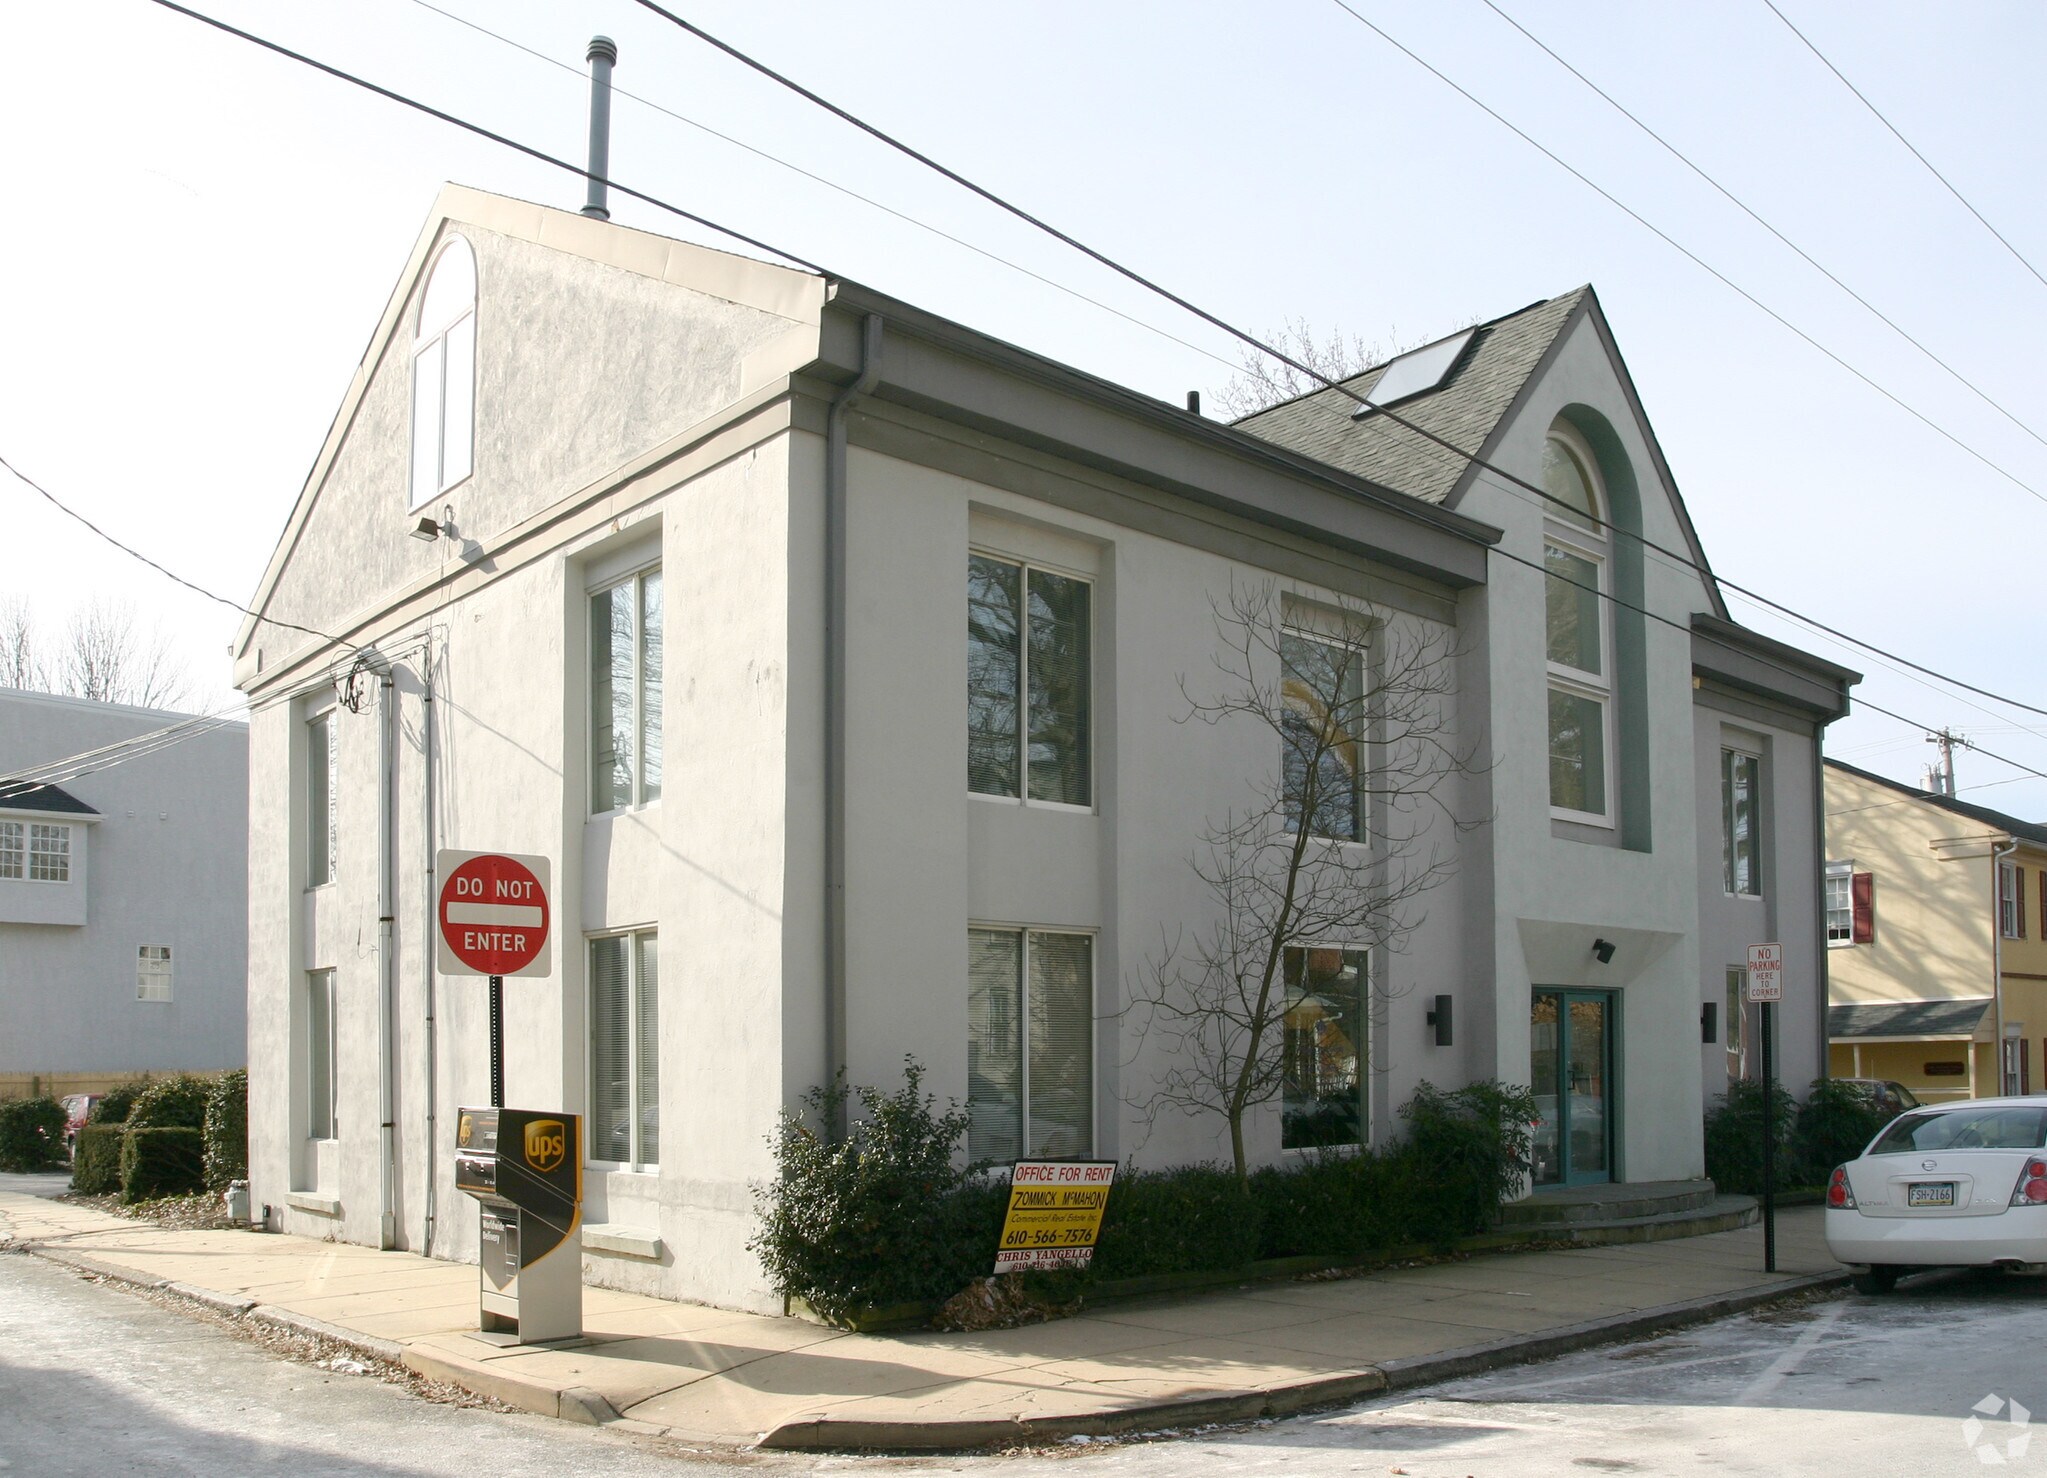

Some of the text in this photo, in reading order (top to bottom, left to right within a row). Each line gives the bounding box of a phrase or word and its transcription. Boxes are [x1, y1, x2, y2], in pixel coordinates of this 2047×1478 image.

[457, 877, 533, 899] DO NOT
[464, 931, 526, 952] ENTER
[1758, 949, 1771, 959] NO
[1749, 960, 1779, 971] PARKING
[528, 1135, 562, 1164] ups
[1015, 1166, 1113, 1182] OFFICE FOR RENT
[1012, 1191, 1057, 1209] ZOMMICK
[1011, 1213, 1050, 1223] Commercial
[1051, 1213, 1066, 1223] Real
[1066, 1213, 1086, 1223] Estate
[1006, 1228, 1092, 1245] 610-566-7576
[996, 1248, 1093, 1262] CHRIS YANGELLO
